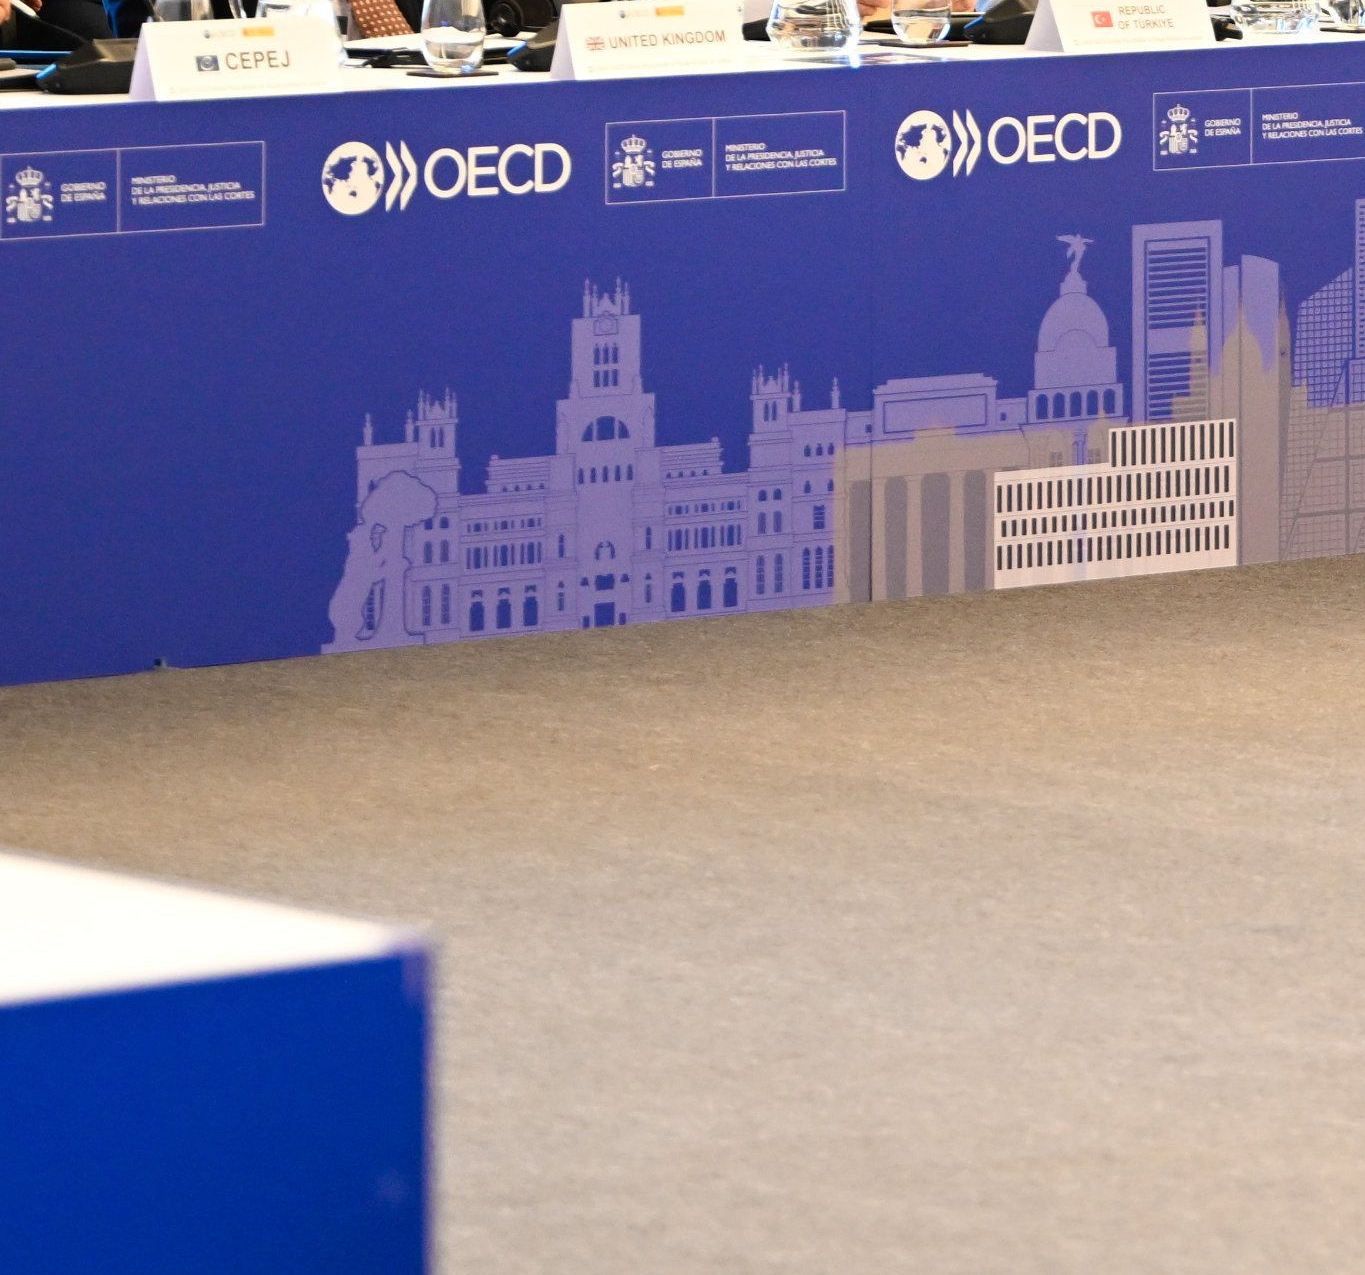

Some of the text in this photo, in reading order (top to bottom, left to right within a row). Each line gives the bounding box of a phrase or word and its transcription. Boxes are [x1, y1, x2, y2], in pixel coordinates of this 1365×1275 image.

[1118, 5, 1166, 15] REPUBLIC
[1118, 19, 1130, 29] OF
[608, 30, 726, 49] UNITED KINGDOM
[224, 49, 291, 70] CEPEJ
[1204, 118, 1240, 127] GOBIERNO
[1262, 113, 1297, 121] MINISTERIO
[1262, 123, 1270, 131] DE
[1272, 122, 1280, 130] LA
[1324, 119, 1350, 127] JUSTICIA
[1215, 127, 1240, 136] ESPAÑA
[1268, 130, 1307, 139] RELACIONES
[1308, 129, 1324, 137] CON
[1338, 127, 1362, 135] CORTES
[988, 112, 1121, 164] OECD
[424, 143, 571, 198] OECD
